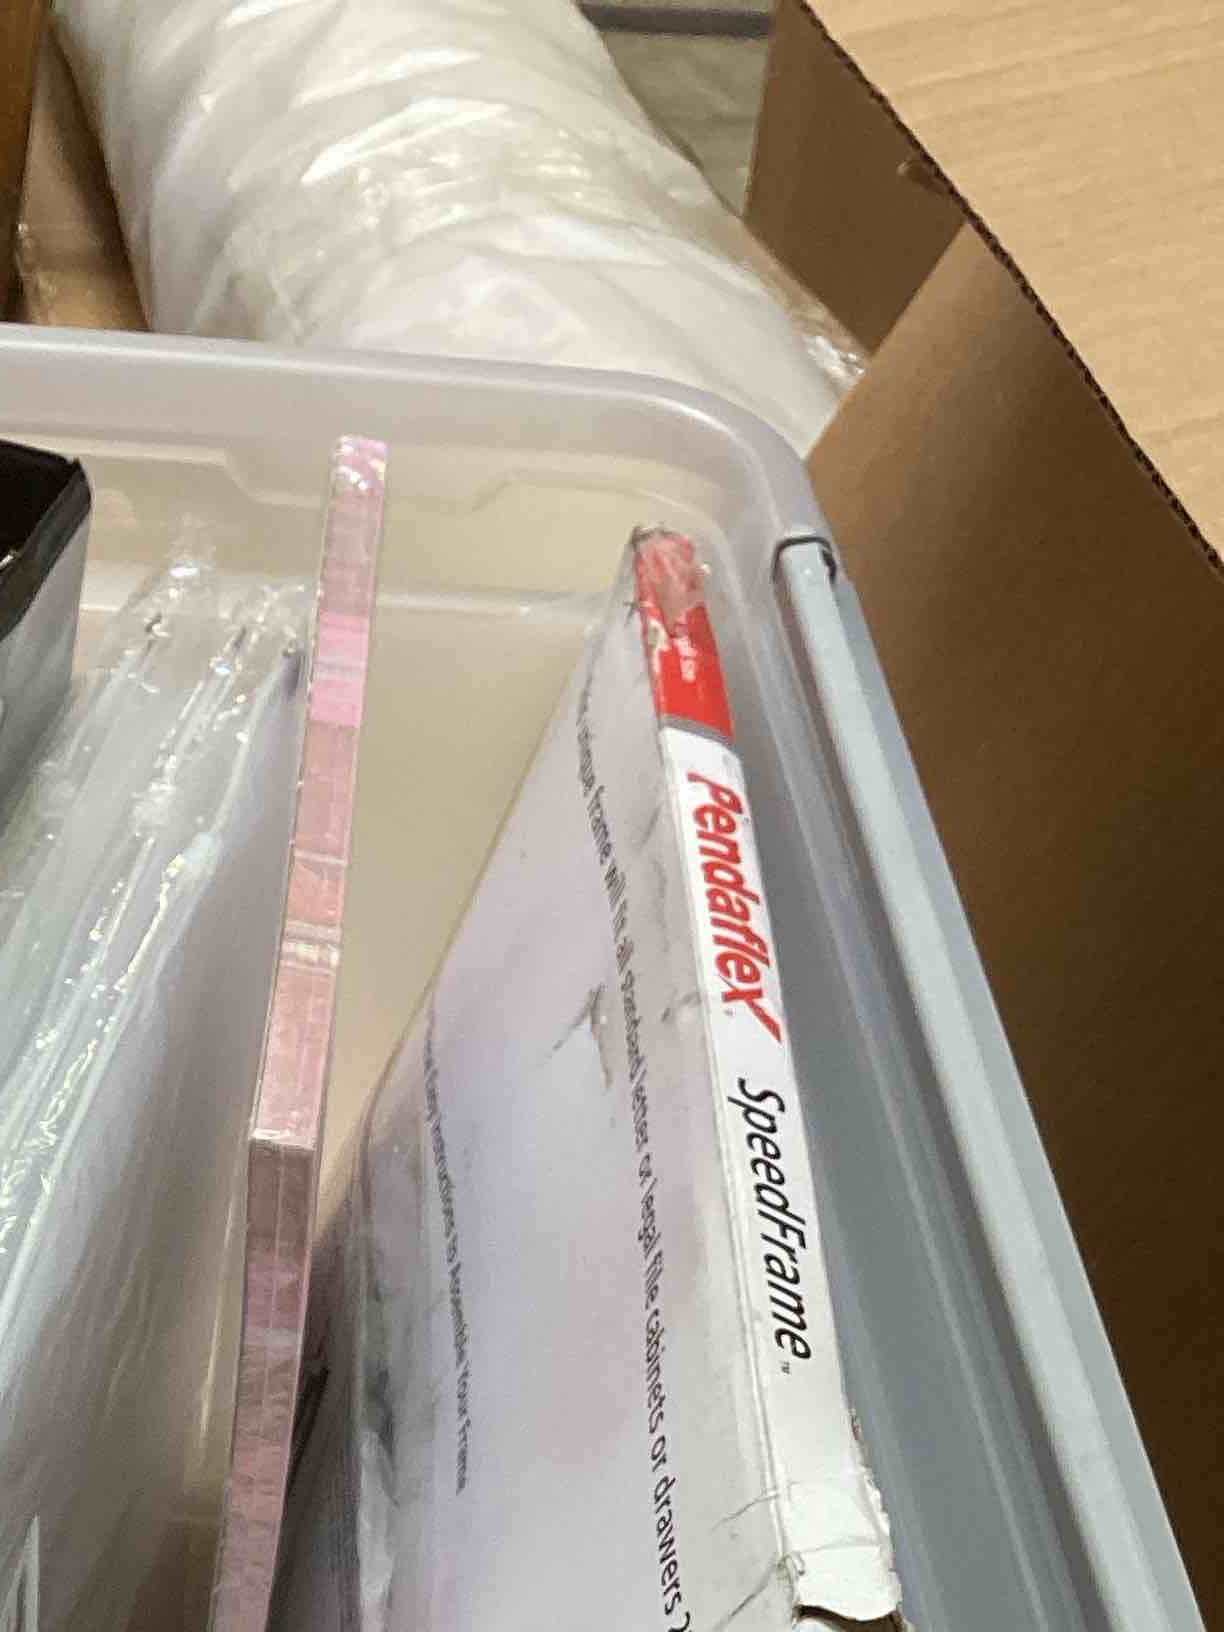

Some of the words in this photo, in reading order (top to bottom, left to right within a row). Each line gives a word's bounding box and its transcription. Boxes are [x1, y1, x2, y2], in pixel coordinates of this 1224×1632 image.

[686, 771, 782, 1043] Pendaflex
[638, 1152, 653, 1187] or
[637, 1177, 661, 1260] legal
[644, 1249, 664, 1310] file
[645, 1308, 666, 1434] cabinets
[650, 1435, 667, 1470] or
[653, 1475, 683, 1616] drawers
